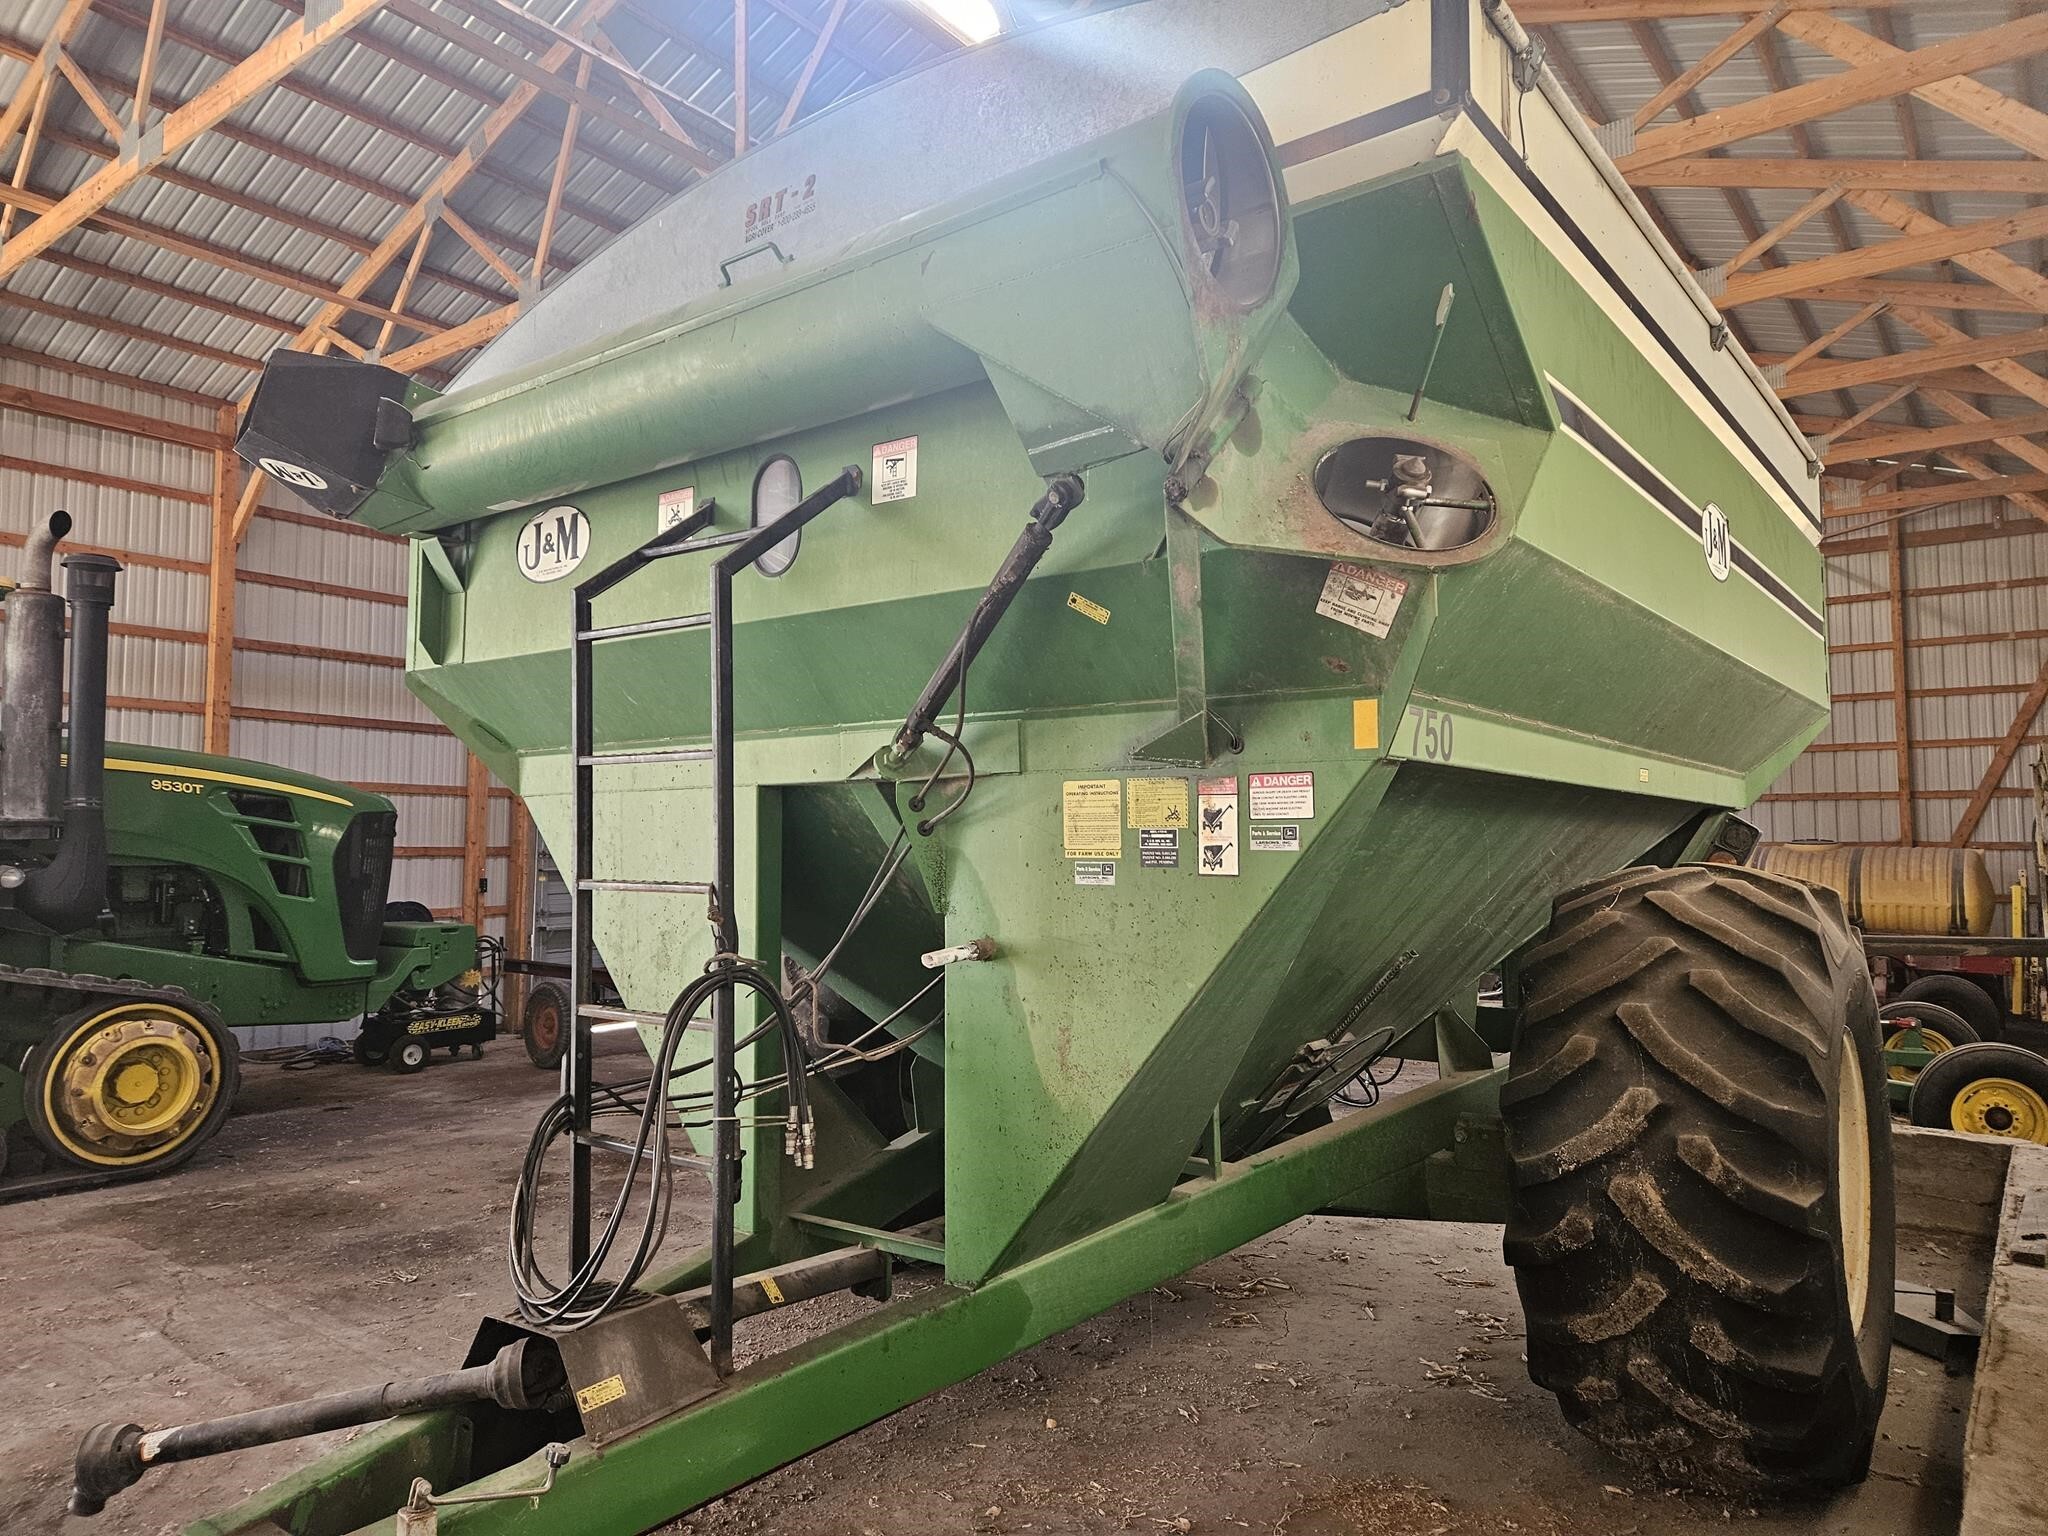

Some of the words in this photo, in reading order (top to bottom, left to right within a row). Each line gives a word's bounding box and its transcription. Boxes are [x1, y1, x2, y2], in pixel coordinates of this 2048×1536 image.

[882, 438, 916, 454] DANGER
[523, 512, 580, 570] J&M
[1705, 511, 1728, 569] J&M
[1346, 565, 1406, 594] DANGER
[1330, 606, 1343, 614] FROM
[1344, 610, 1360, 621] MOVING
[1408, 706, 1453, 761] 750
[151, 779, 204, 794] 9530T
[1264, 775, 1311, 786] DANGER
[413, 1017, 462, 1030] EASY-KLEEN
